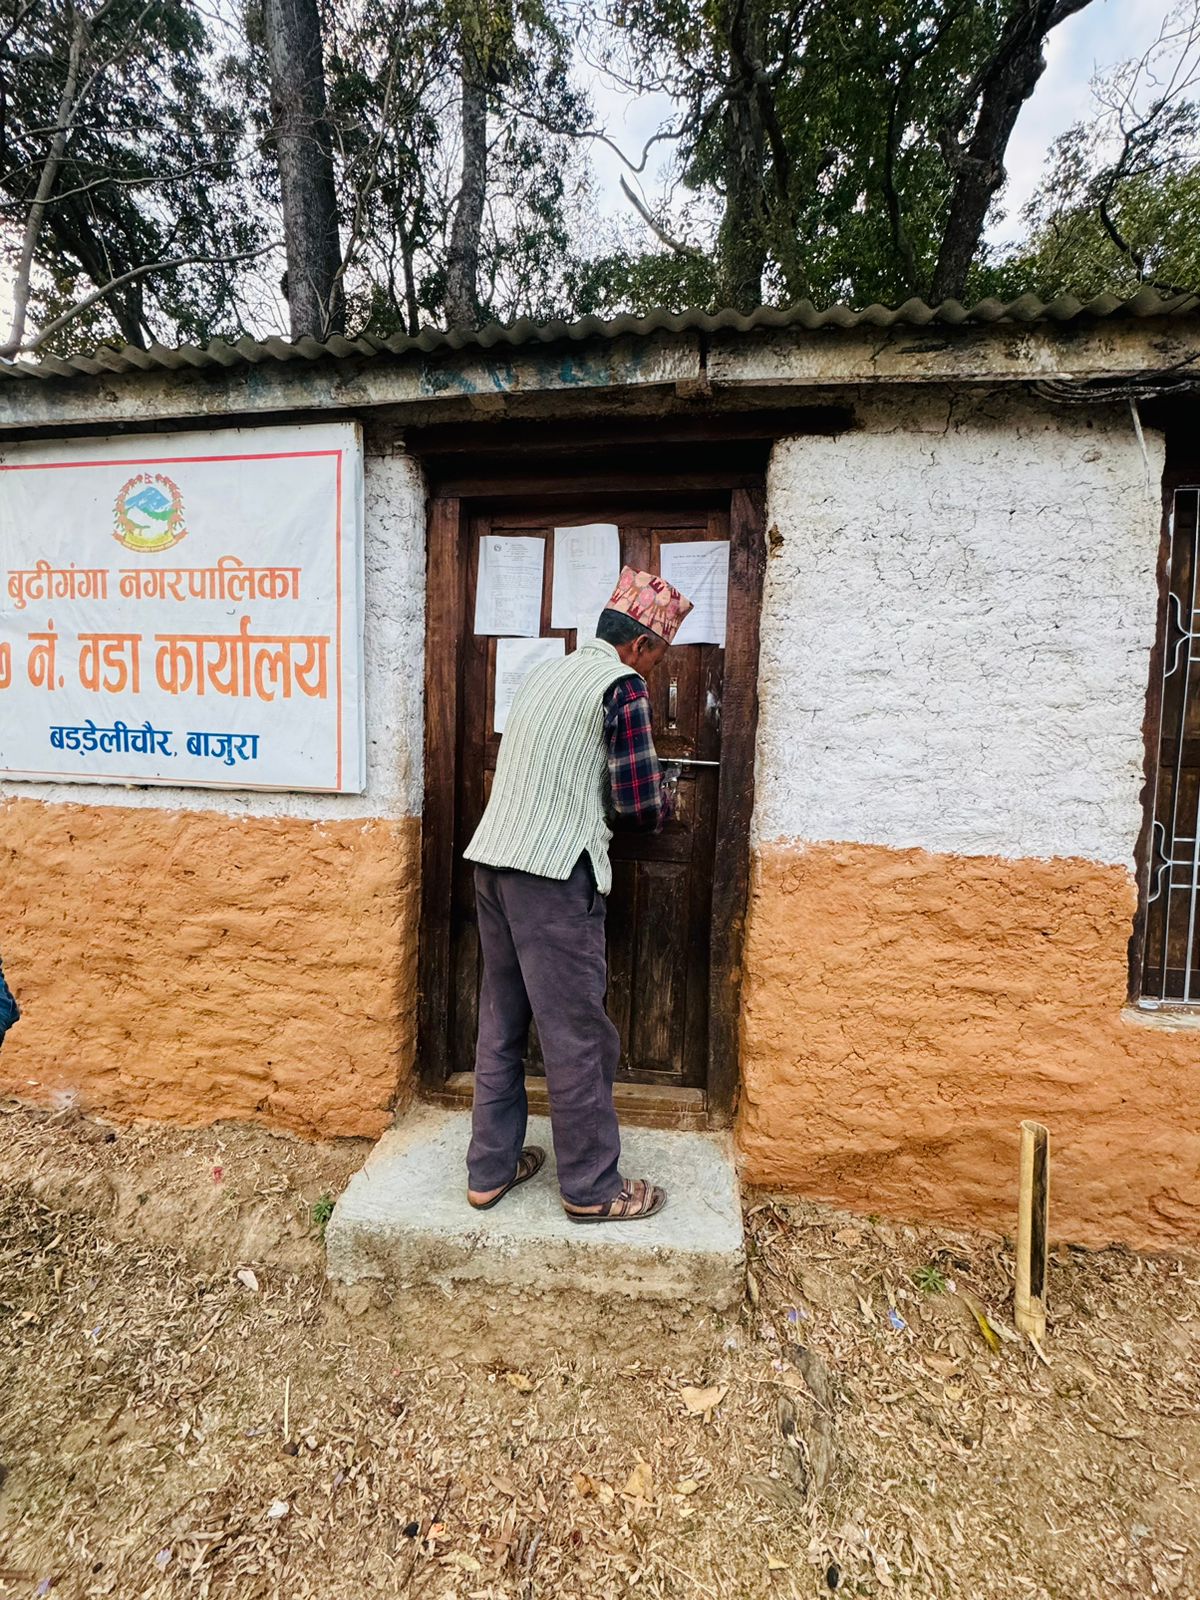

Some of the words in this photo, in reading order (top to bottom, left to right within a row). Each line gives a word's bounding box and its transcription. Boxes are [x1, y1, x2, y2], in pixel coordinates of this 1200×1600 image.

[7, 559, 109, 609] बुढीगंगा
[119, 555, 302, 602] नगरपालिका
[27, 616, 65, 692] नं.
[77, 633, 143, 694] वडा
[154, 615, 331, 702] कार्यालय
[185, 731, 261, 767] बाजुरा
